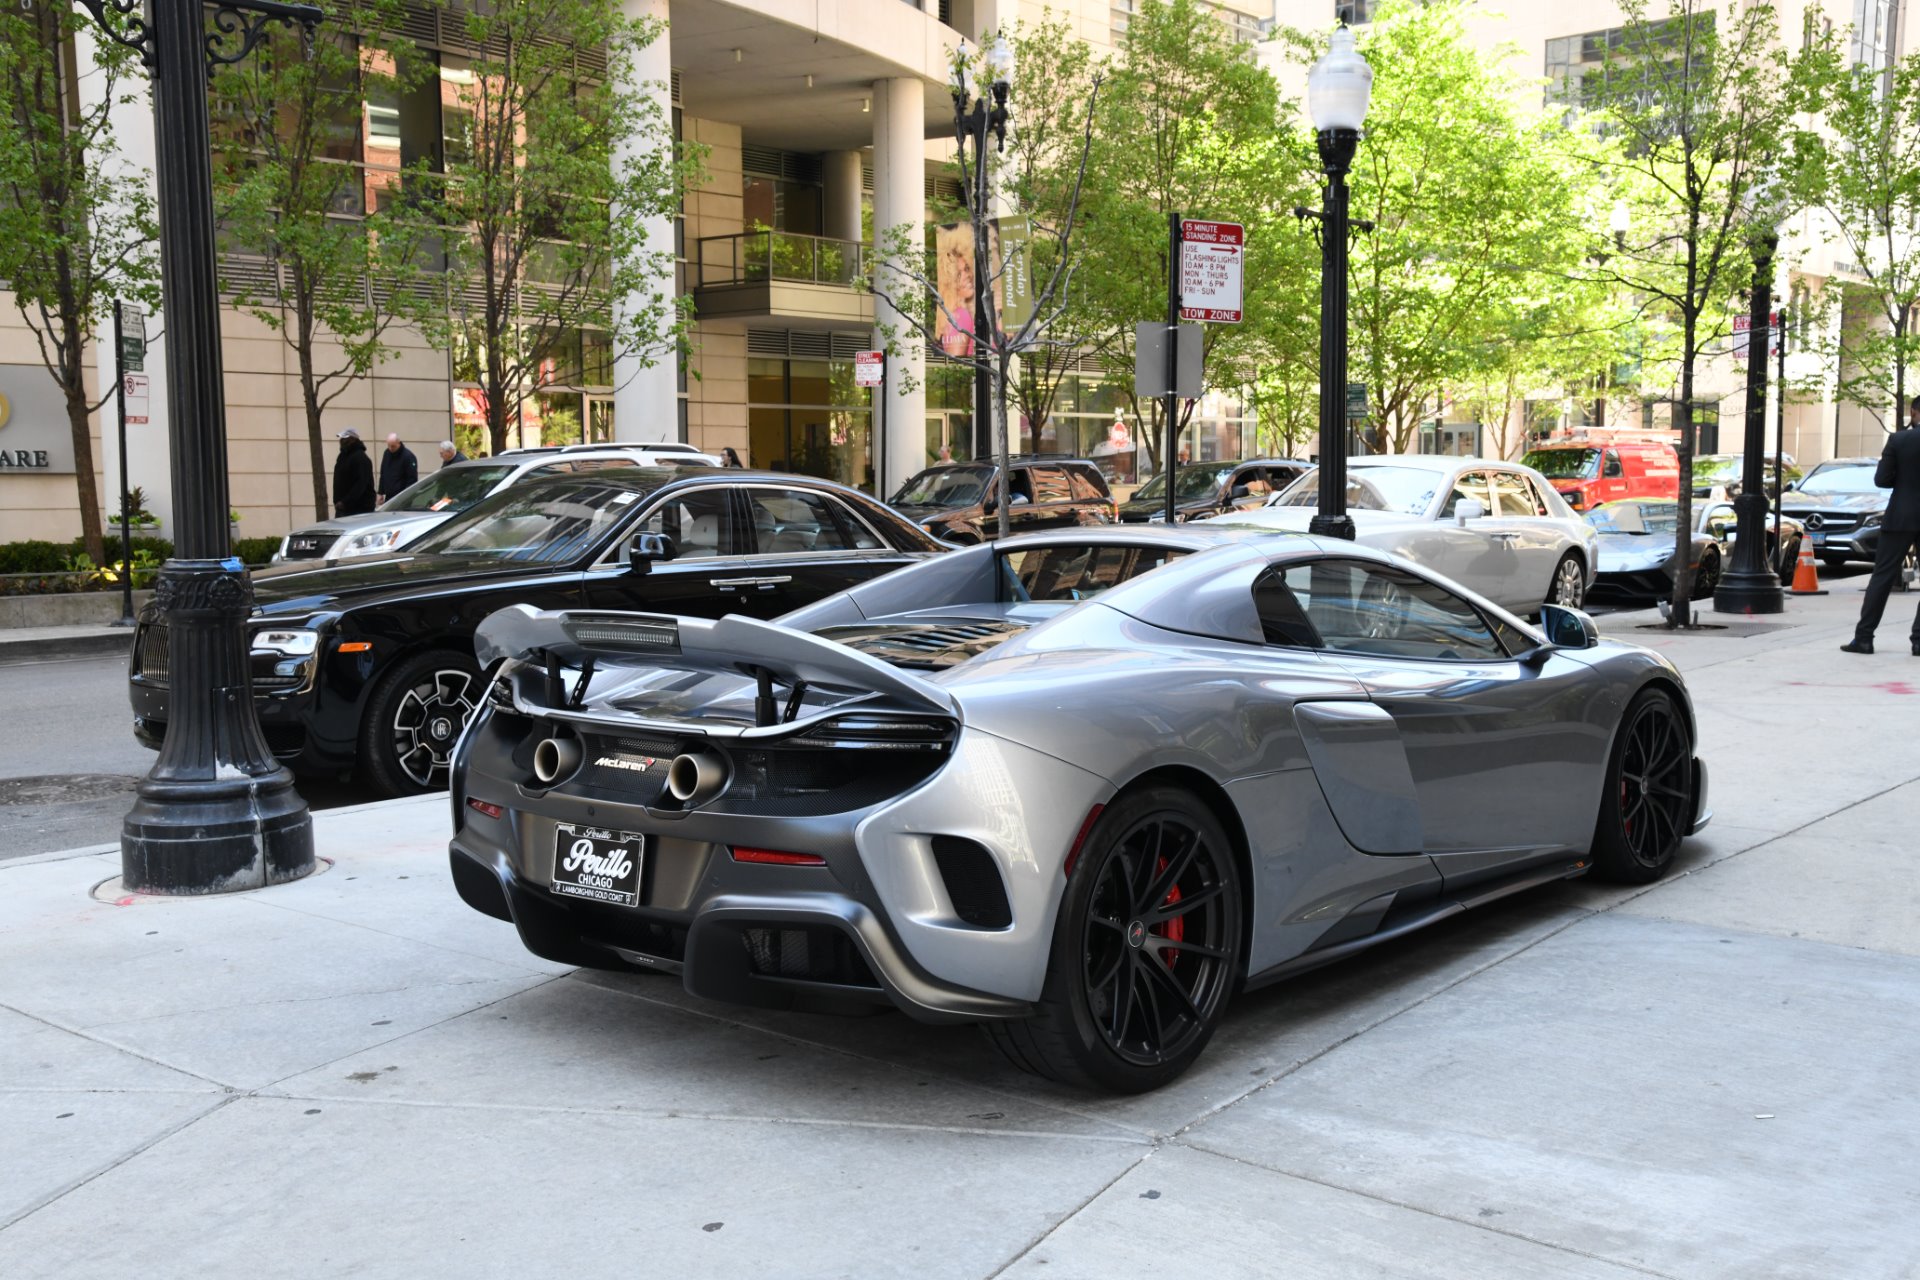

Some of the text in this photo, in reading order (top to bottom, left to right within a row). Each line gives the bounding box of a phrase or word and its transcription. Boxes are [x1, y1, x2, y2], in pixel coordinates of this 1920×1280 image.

[1186, 223, 1217, 233] 15 MINUTE
[1186, 232, 1236, 243] STANDING ZONE
[1185, 245, 1198, 253] USE
[1185, 253, 1239, 265] FLASHING LIGHTS
[1015, 238, 1026, 297] Eeryday
[1209, 263, 1214, 271] 8
[1185, 270, 1200, 278] MON
[1206, 271, 1229, 280] THURS
[1215, 280, 1225, 288] PM
[1185, 286, 1196, 294] FRI
[1201, 288, 1216, 296] SUN
[1185, 308, 1236, 321] TOW ZONE
[594, 757, 646, 772] McLaren
[563, 839, 632, 880] Perillo
[578, 873, 613, 889] CHICAGO
[562, 885, 624, 902] LAMBORGHINI GOLD COAST
